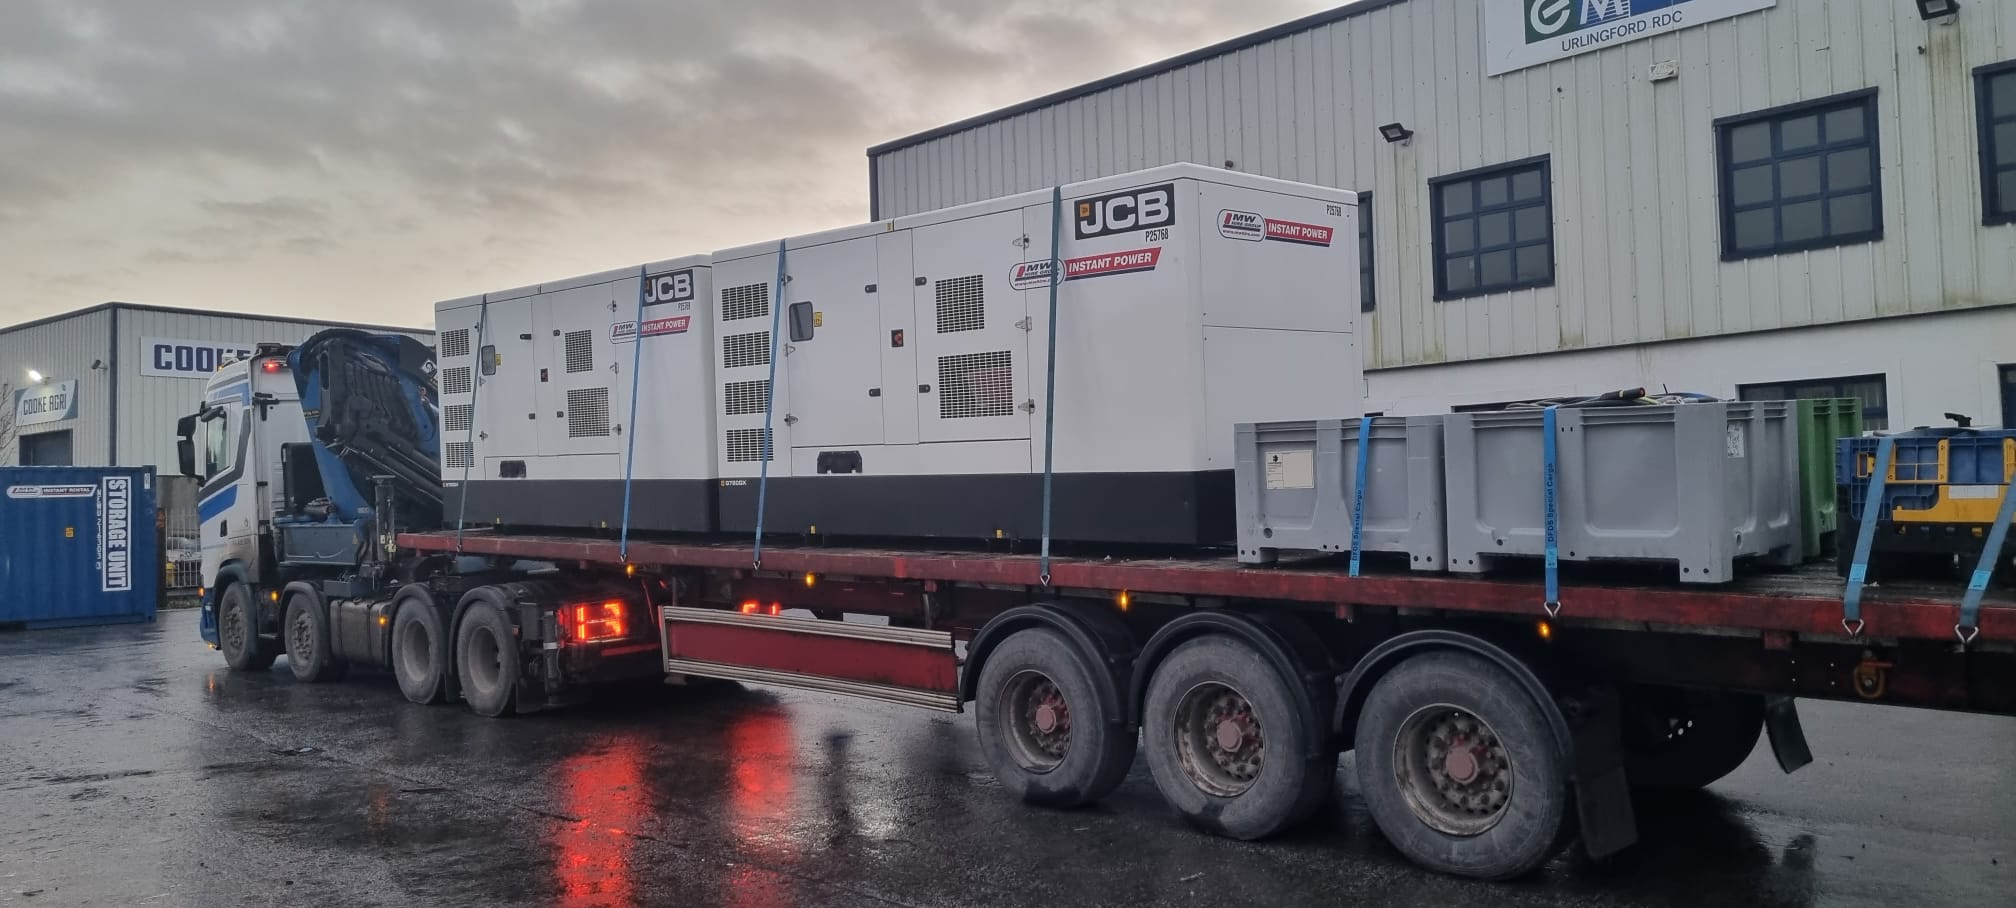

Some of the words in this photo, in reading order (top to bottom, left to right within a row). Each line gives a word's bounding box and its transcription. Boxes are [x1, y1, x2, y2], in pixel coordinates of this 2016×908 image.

[1561, 20, 1647, 51] URLINGFORD
[1653, 10, 1683, 29] RDC
[1080, 190, 1170, 235] JCB
[1232, 213, 1257, 223] MW
[1145, 228, 1169, 242] P25768
[1268, 222, 1301, 236] INSTANT
[1301, 227, 1328, 240] POWER
[1026, 261, 1053, 272] MW
[1068, 257, 1112, 273] INSTANT
[1113, 252, 1152, 267] POWER
[644, 273, 691, 303] JCB
[641, 322, 664, 332] INSTANT
[665, 319, 686, 329] POWER
[23, 396, 47, 416] COOKE
[108, 479, 127, 548] STORAGE
[108, 550, 127, 587] UNIT
